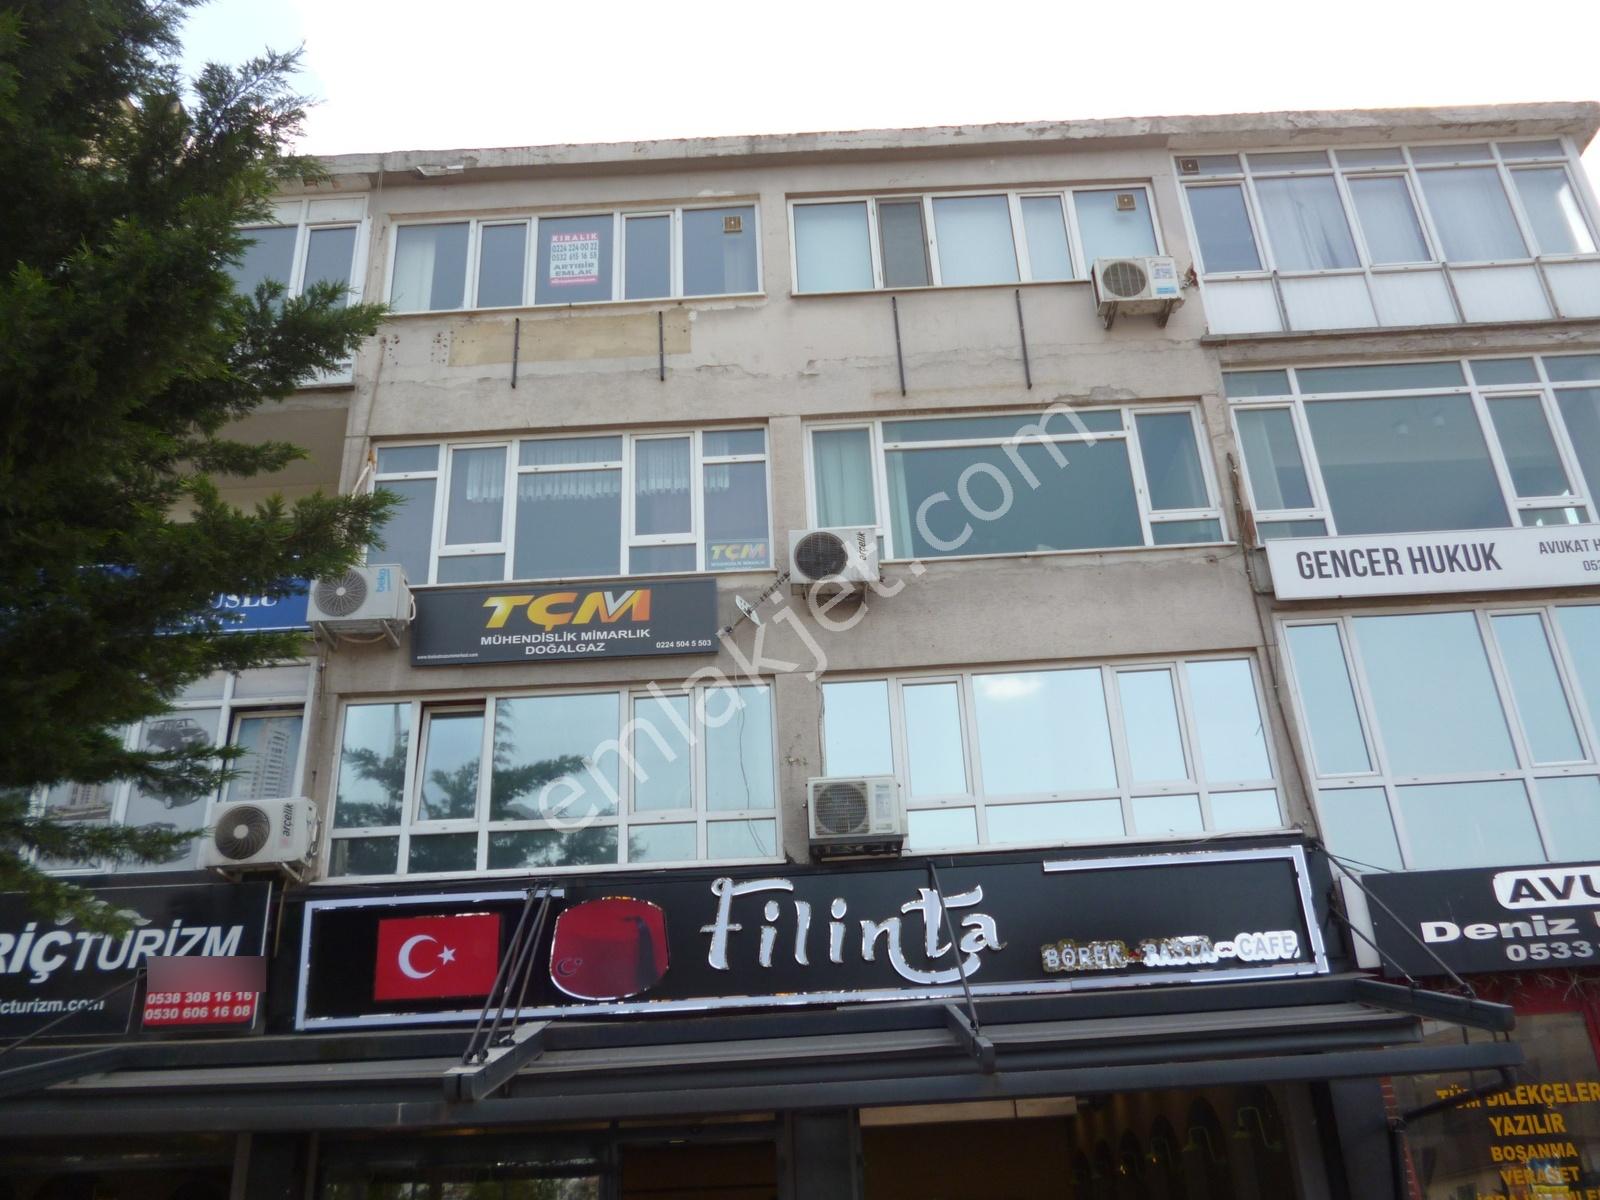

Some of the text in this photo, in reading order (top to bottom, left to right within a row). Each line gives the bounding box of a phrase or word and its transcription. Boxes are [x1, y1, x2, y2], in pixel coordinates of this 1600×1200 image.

[1539, 539, 1589, 554] AVUKAT
[1296, 542, 1503, 579] GENCER HUKUK
[482, 589, 652, 631] TÇM
[480, 628, 650, 646] MÜHENDİSLİK MİMARLIK
[656, 641, 674, 649] 0224
[676, 640, 690, 648] 504
[698, 639, 712, 647] 503
[525, 642, 606, 655] DOĞALGAZ
[283, 803, 293, 837] arçelik
[700, 876, 1007, 984] Filinta
[1421, 915, 1580, 943] Deniz
[1046, 943, 1123, 968] BÖREK
[1147, 942, 1215, 963] PASTA
[1239, 934, 1294, 956] CAFE
[1506, 940, 1593, 962] 0533
[147, 990, 253, 1005] 0538 308 16 16
[145, 1005, 250, 1020] 0530 606 16 08
[1488, 1113, 1567, 1137] YAZILIR
[1490, 1142, 1578, 1164] BOŞANMA
[1500, 1166, 1580, 1186] VERASET
